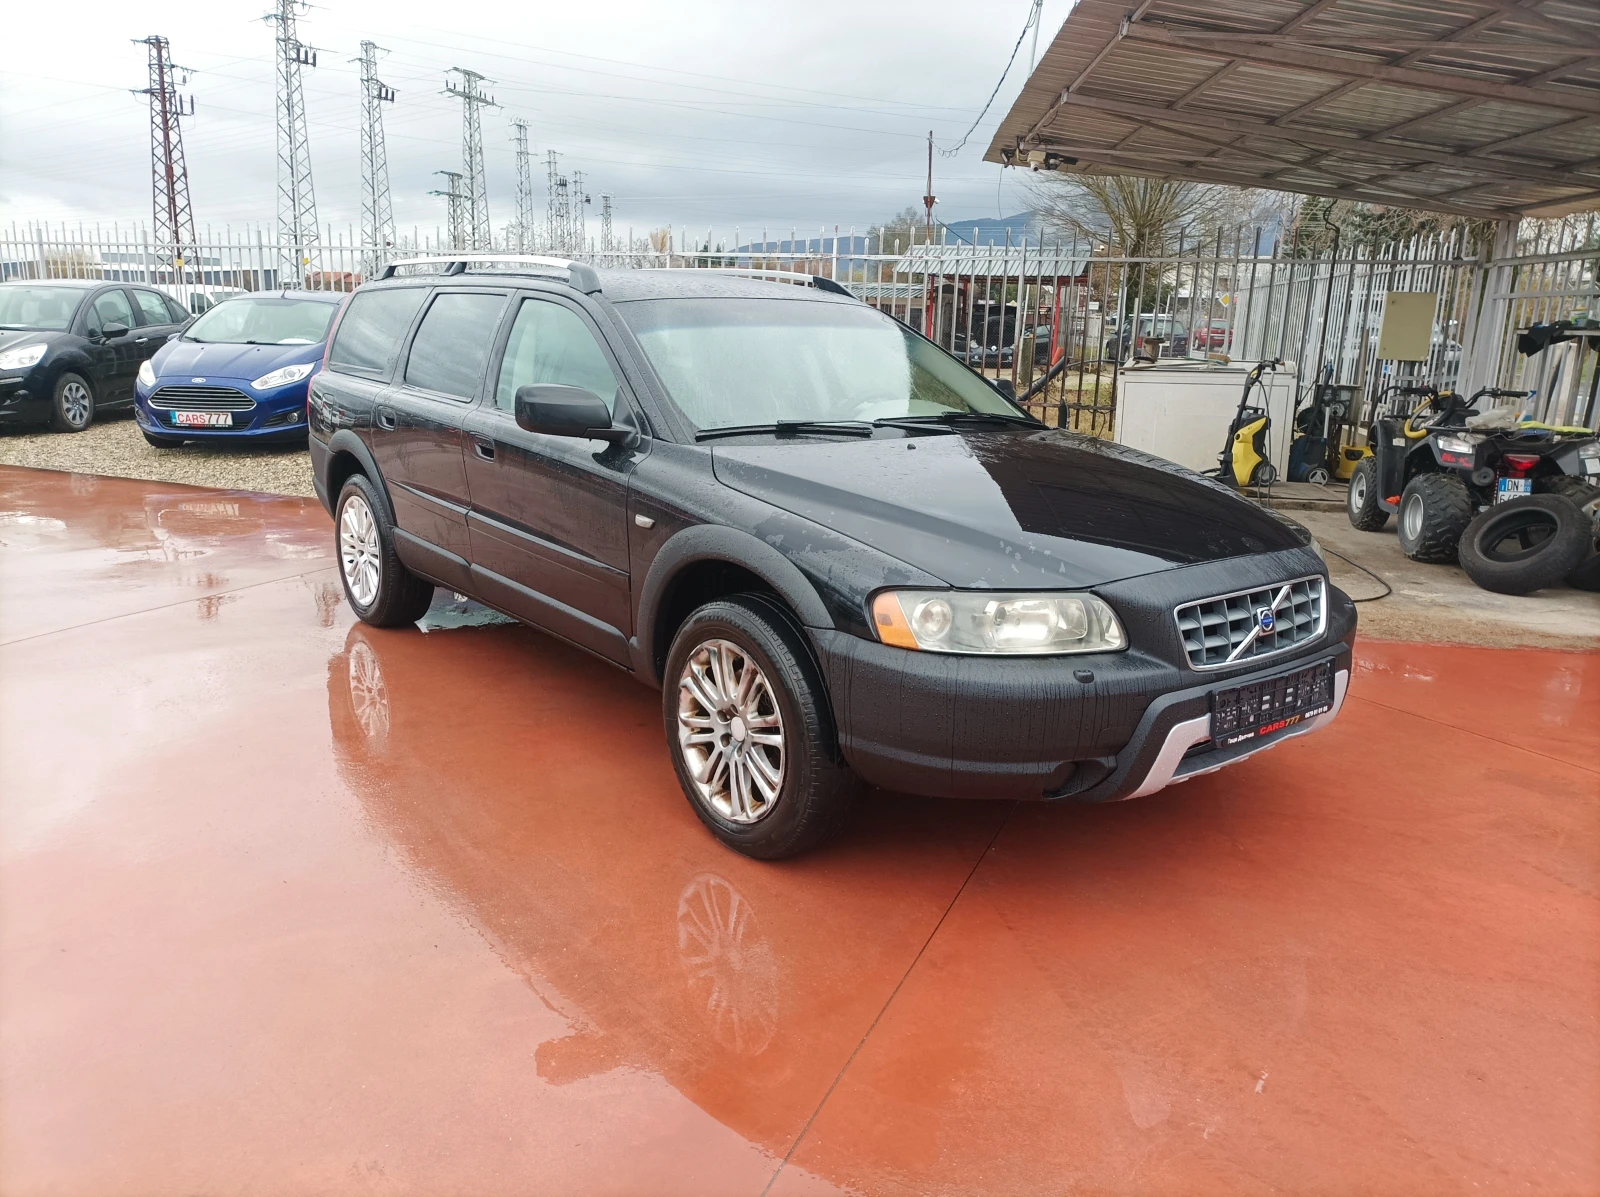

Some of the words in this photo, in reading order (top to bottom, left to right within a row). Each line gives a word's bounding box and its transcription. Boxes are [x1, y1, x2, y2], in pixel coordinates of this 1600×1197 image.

[177, 412, 230, 424] CARS777
[1507, 480, 1520, 491] DN
[1259, 715, 1301, 735] CARS777
